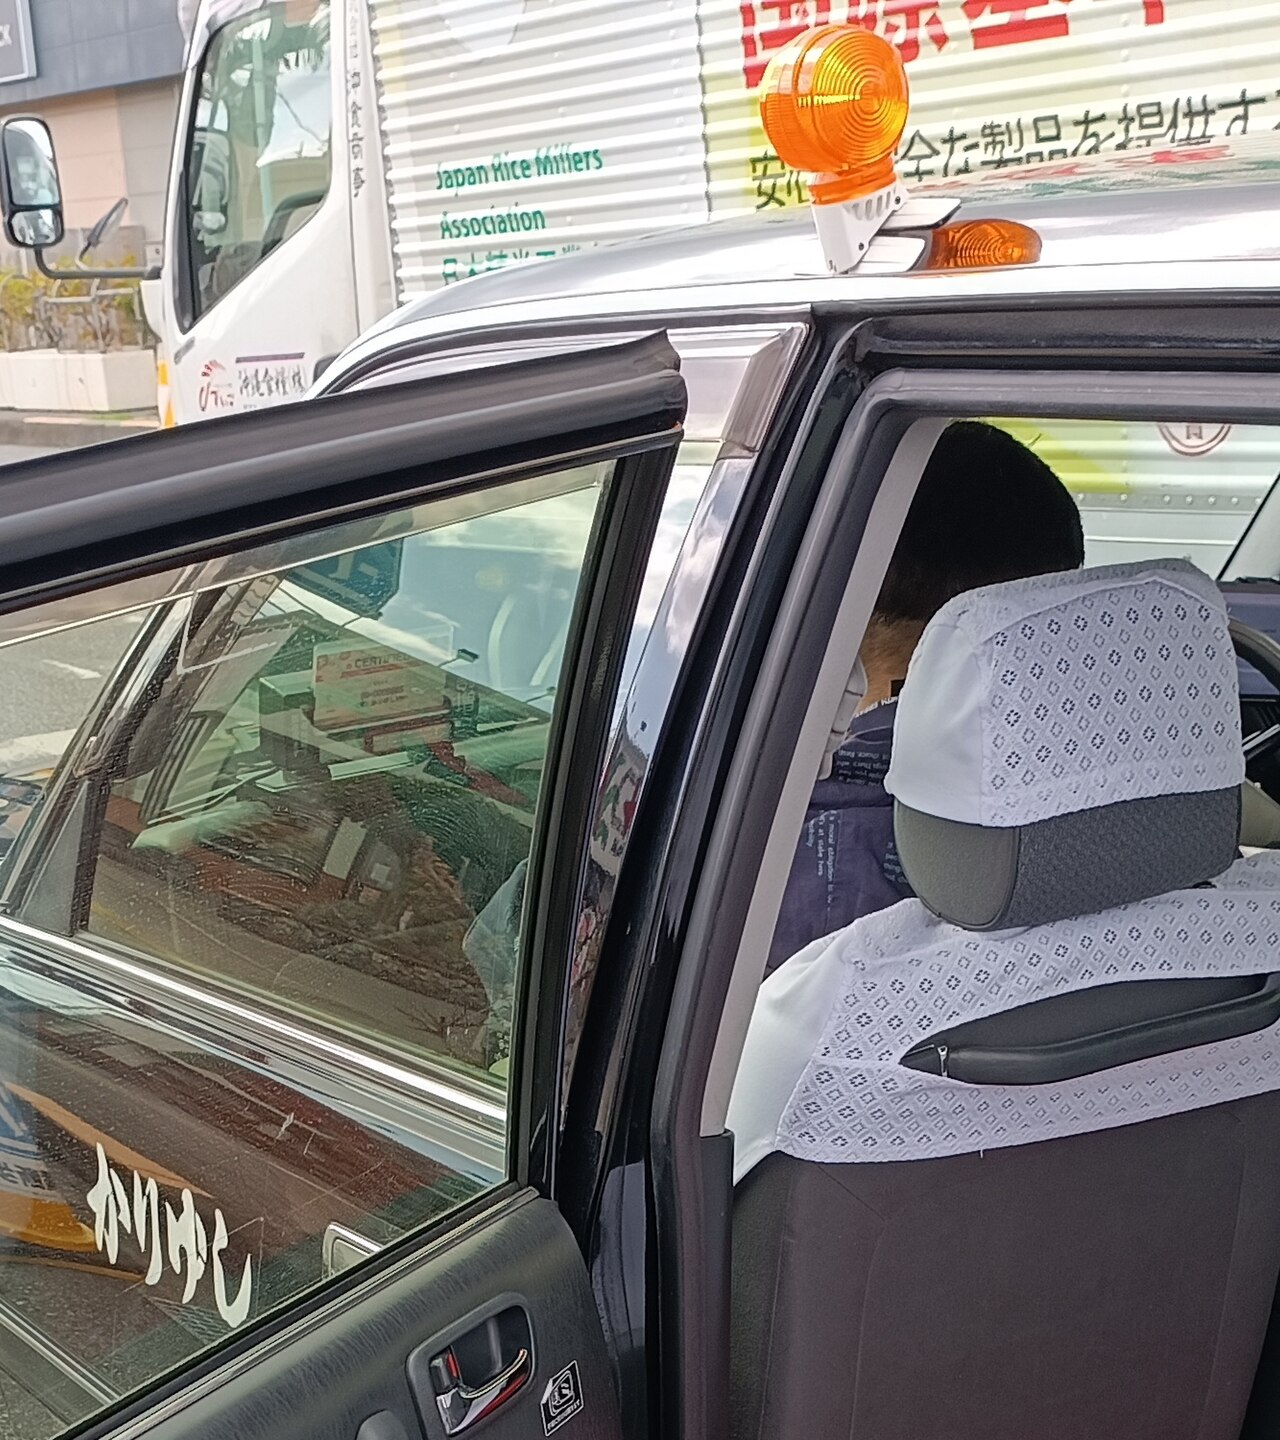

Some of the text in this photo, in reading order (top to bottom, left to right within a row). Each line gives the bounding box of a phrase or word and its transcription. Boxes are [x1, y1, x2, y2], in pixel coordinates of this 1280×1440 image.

[436, 143, 603, 197] Japan Rice Millers
[441, 202, 546, 239] Association
